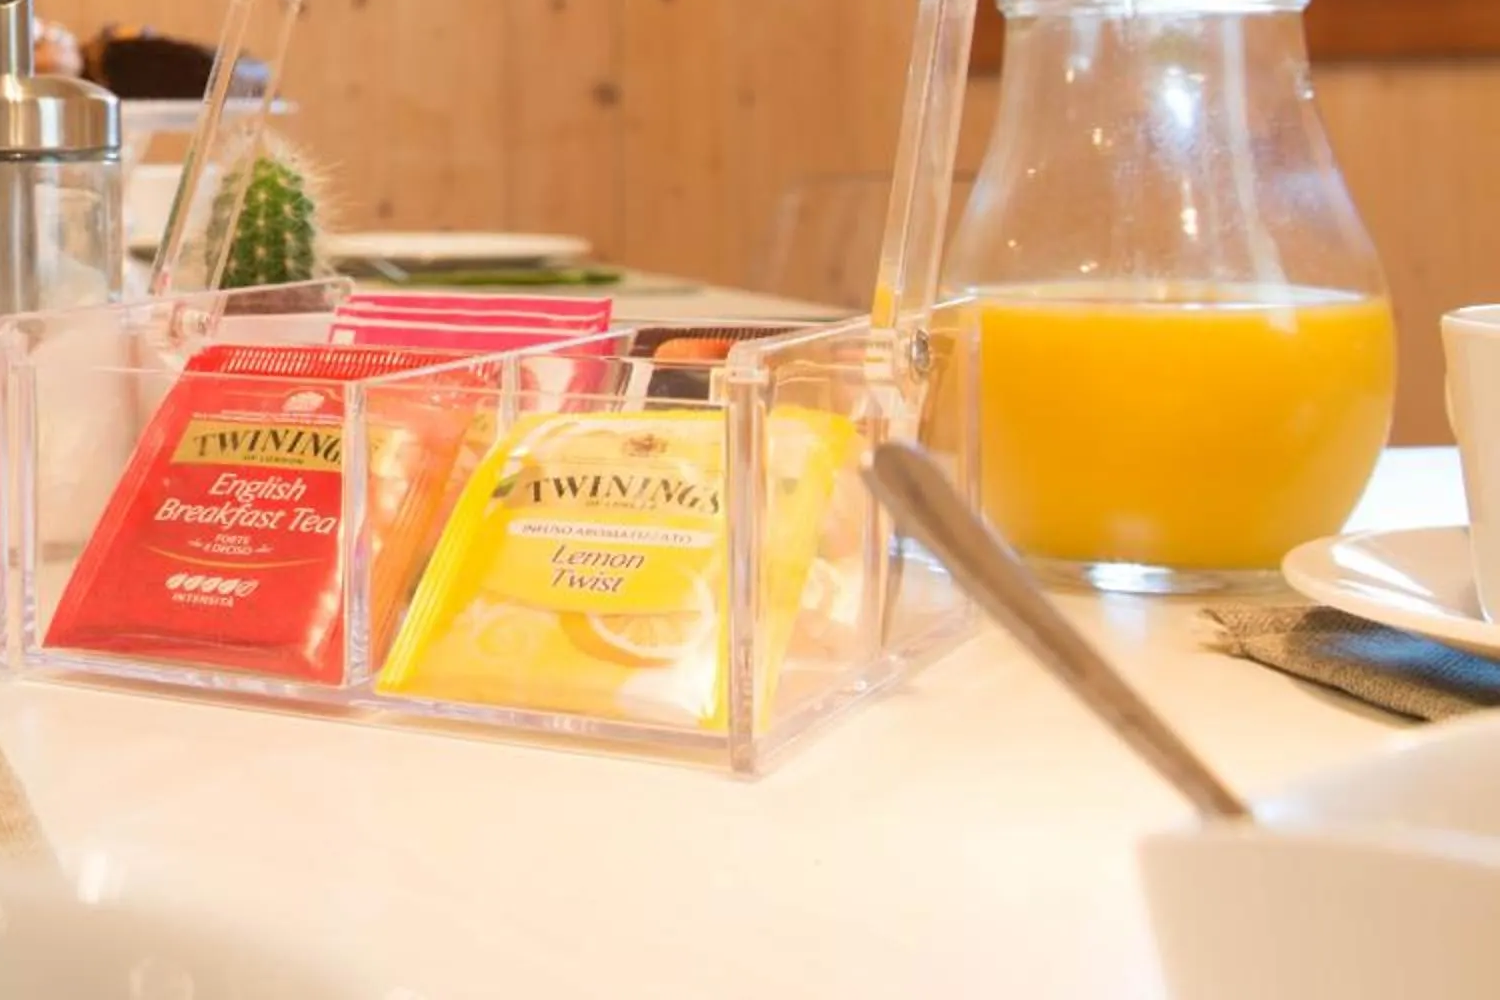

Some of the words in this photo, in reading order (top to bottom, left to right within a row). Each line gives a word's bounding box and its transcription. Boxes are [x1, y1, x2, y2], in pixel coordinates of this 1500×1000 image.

[193, 428, 342, 465] TWINING
[208, 473, 307, 502] English
[525, 475, 720, 514] TWININGS
[155, 498, 287, 529] Breakfast
[289, 507, 338, 534] Tea
[552, 545, 644, 569] Lemon
[551, 569, 624, 593] Twist
